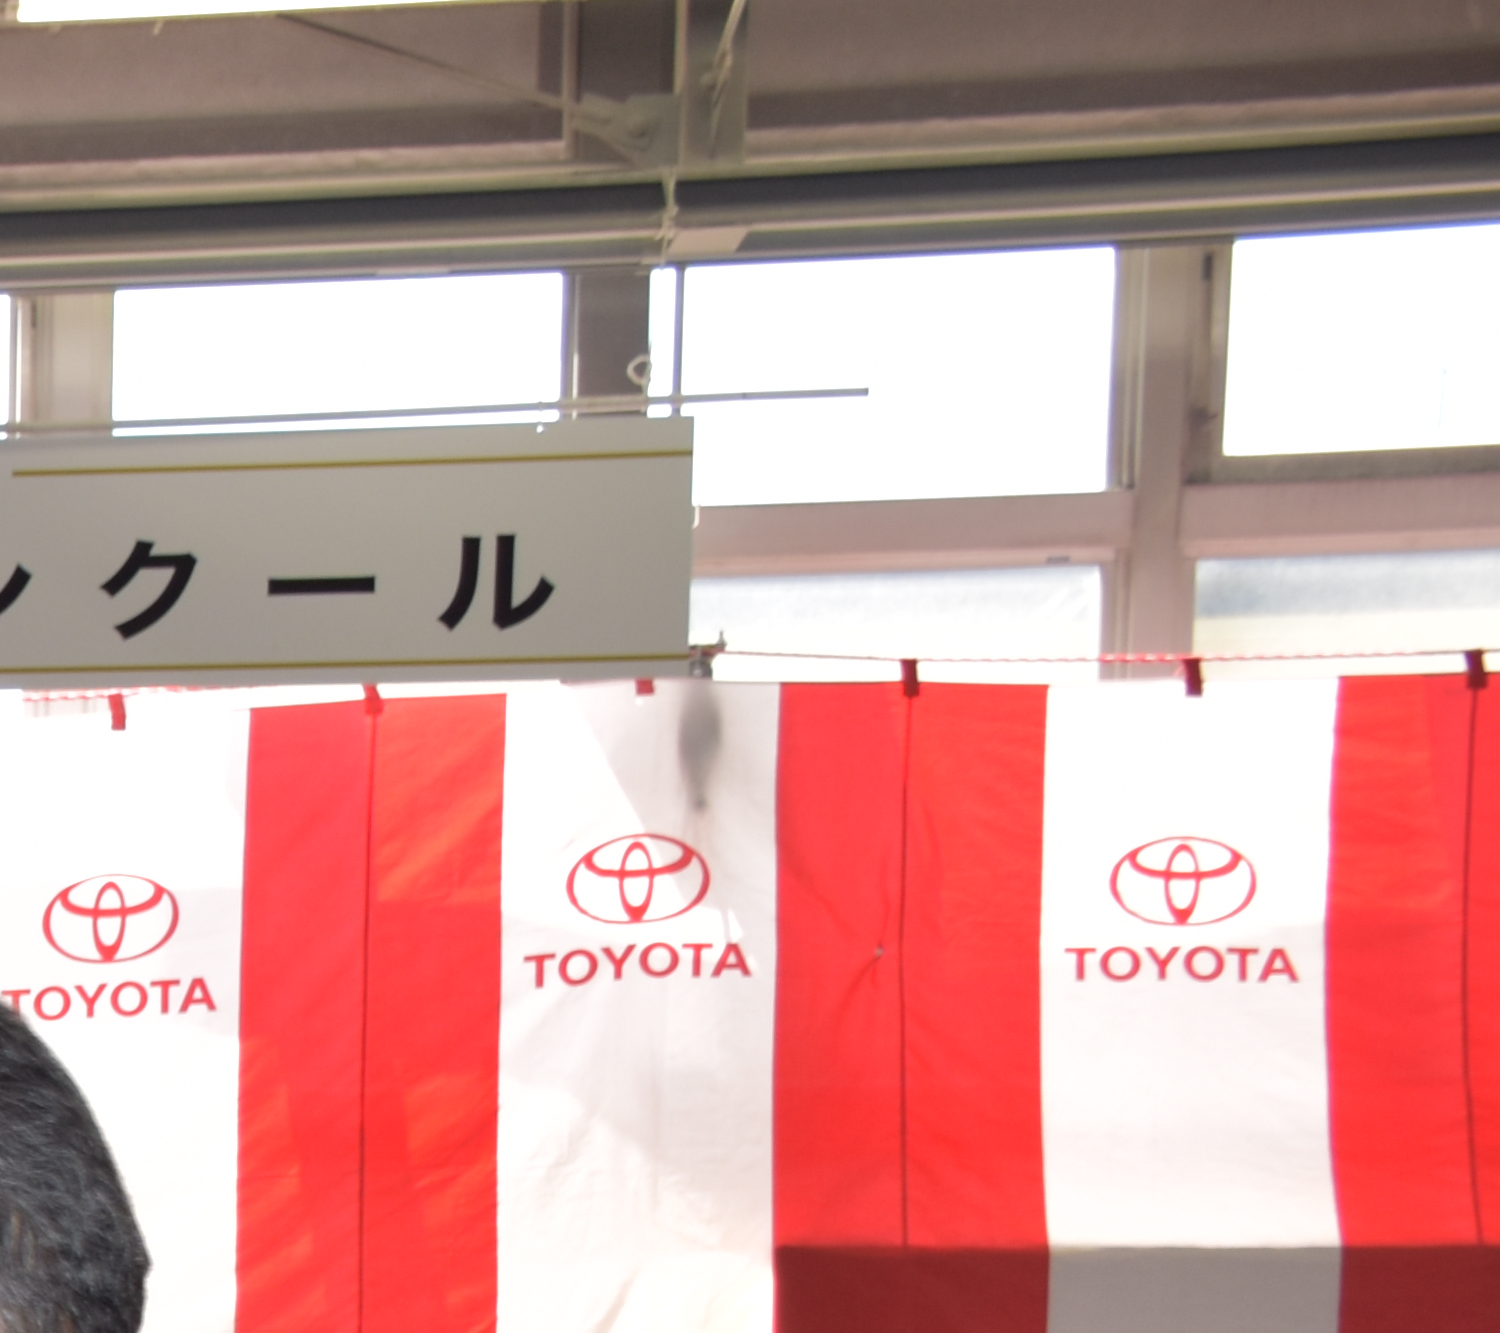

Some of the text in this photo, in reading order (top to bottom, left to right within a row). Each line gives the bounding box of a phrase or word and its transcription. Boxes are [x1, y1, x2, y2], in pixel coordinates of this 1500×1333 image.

[524, 942, 752, 988] TOYOTA
[1065, 945, 1300, 983] TOYOTA
[1, 977, 217, 1022] TOYOTA
